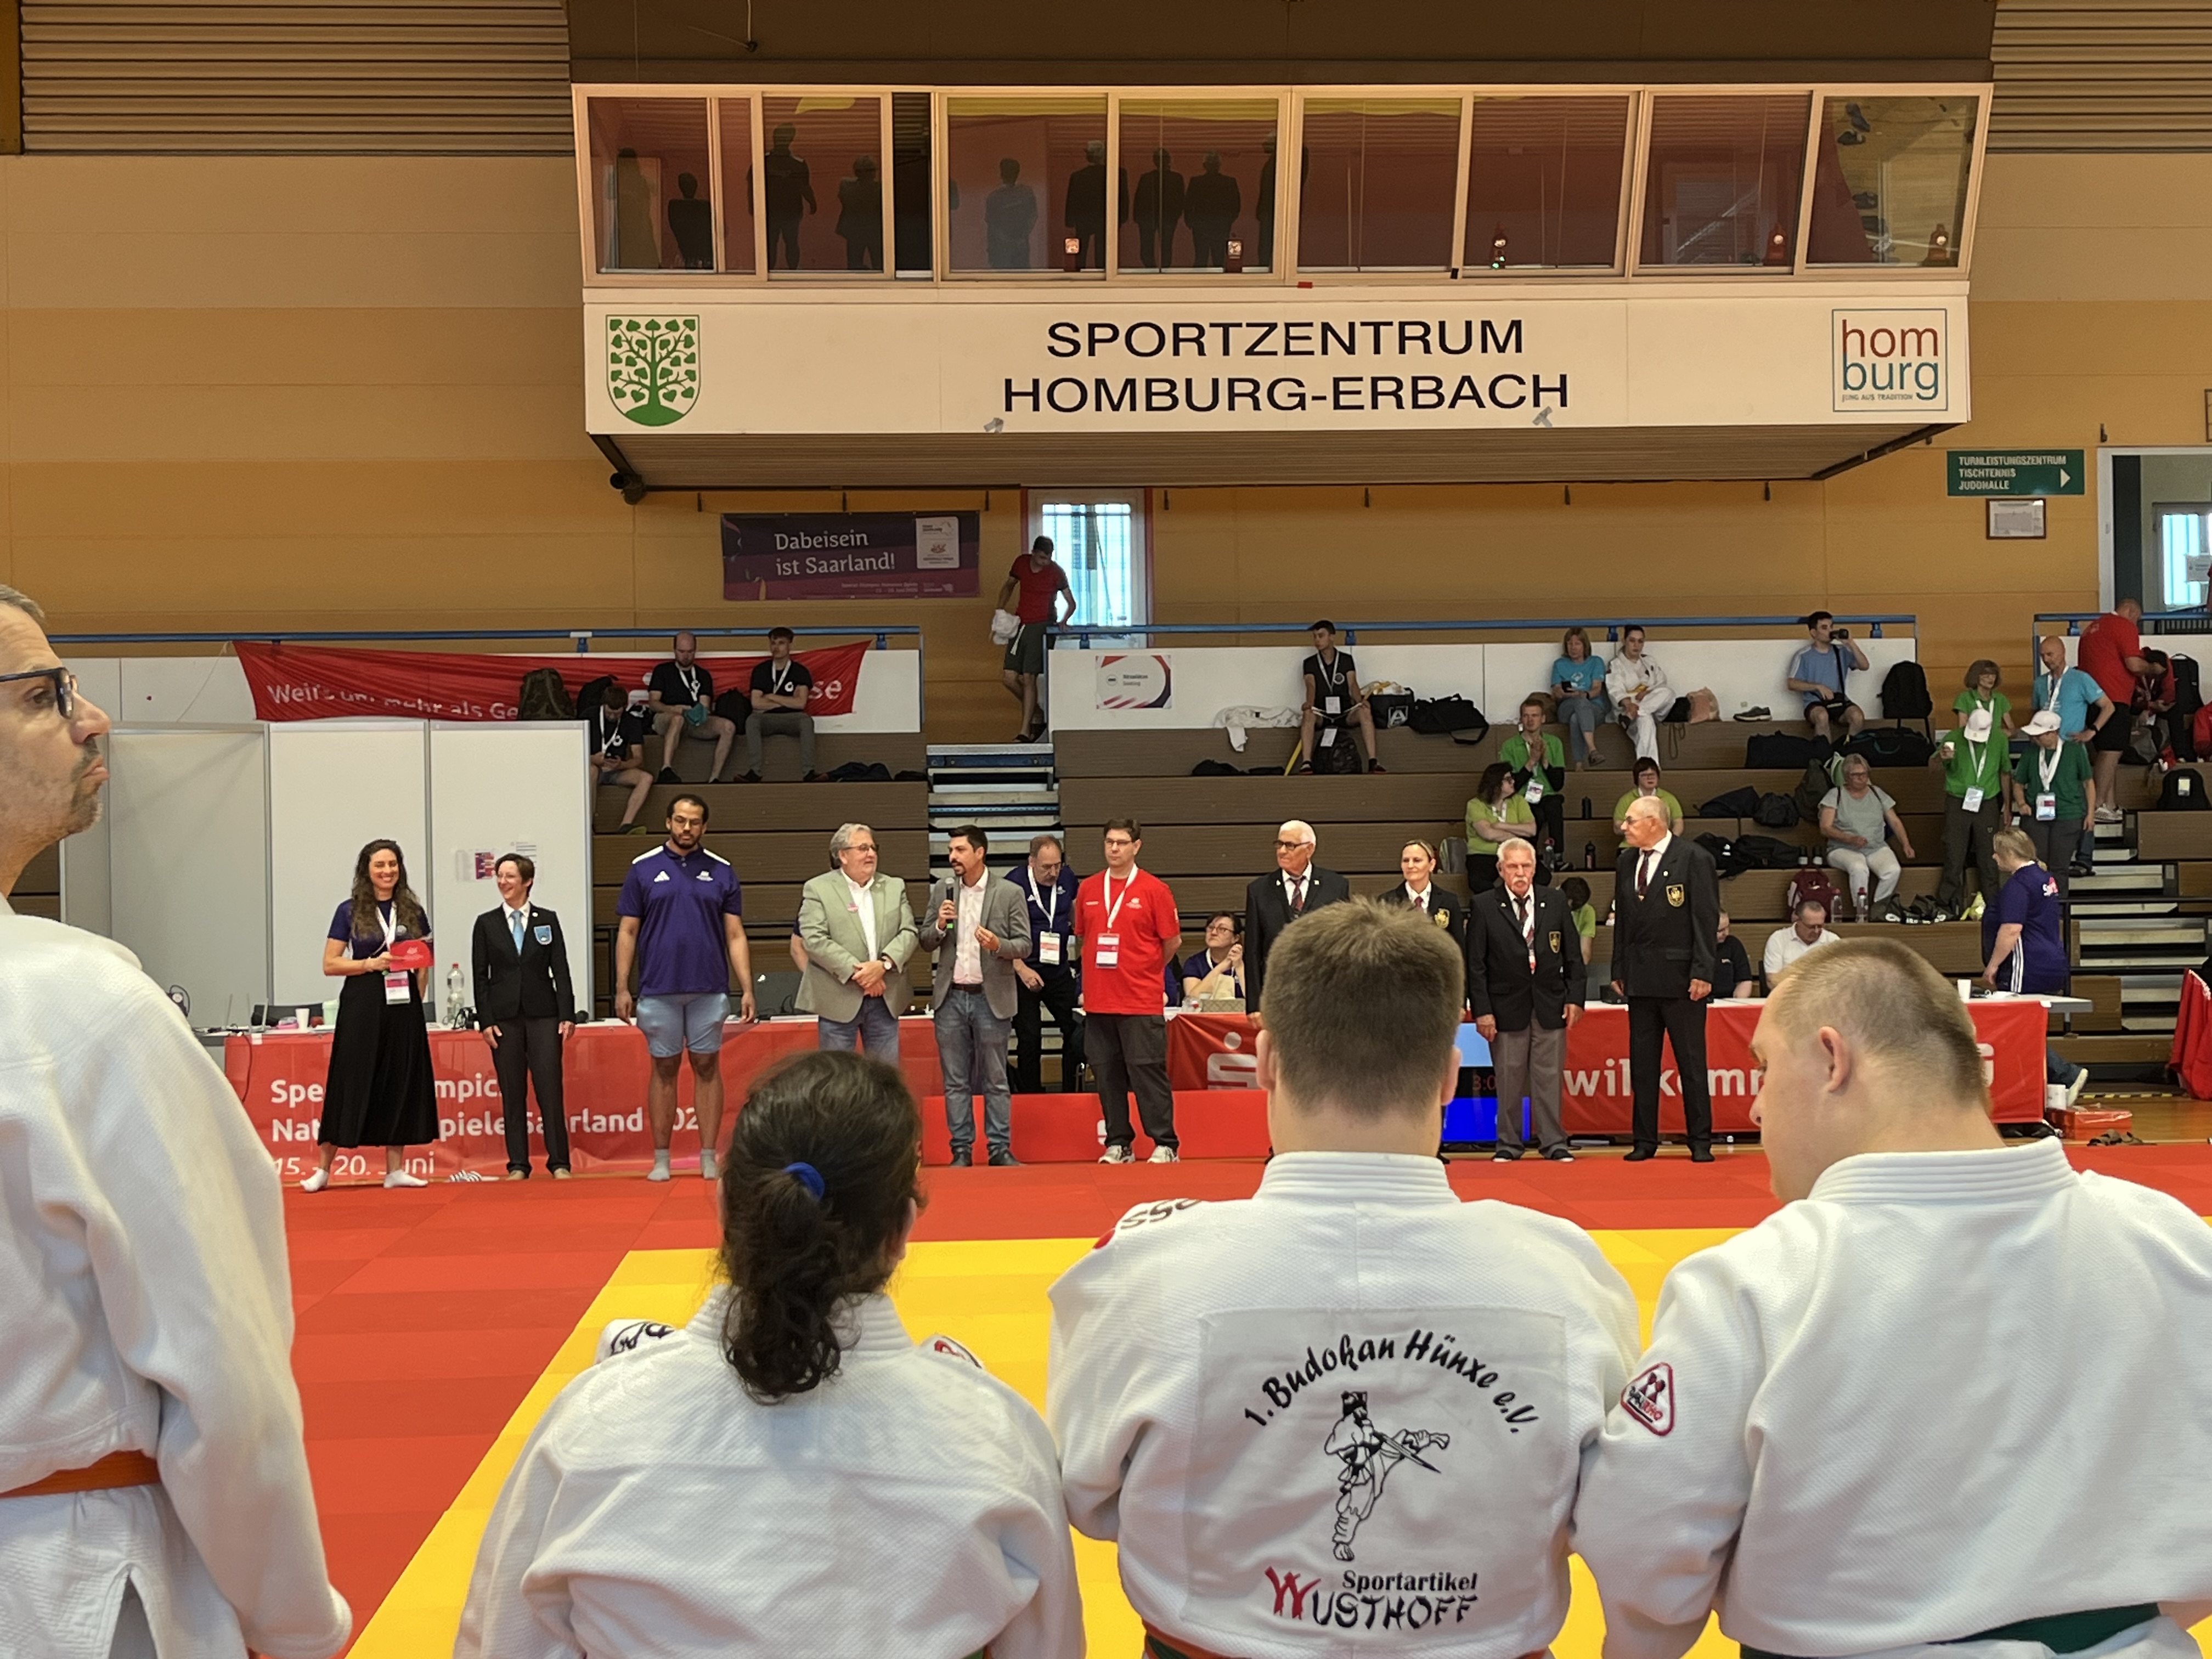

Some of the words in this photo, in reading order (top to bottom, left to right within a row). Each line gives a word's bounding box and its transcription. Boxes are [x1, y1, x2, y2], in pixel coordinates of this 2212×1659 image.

[1047, 319, 1523, 358] SPORTZENTRUM
[1842, 319, 1938, 358] hom
[1842, 358, 1938, 401] burg
[1005, 374, 1568, 414] HOMBURG-ERBACH
[1958, 467, 2016, 478] TISCHTENNIS
[774, 529, 869, 550] Dabeisein
[776, 558, 800, 575] ist
[805, 552, 895, 574] Saarland!
[489, 702, 518, 719] Ge
[334, 1155, 371, 1175] 20.
[1244, 1406, 1274, 1426] 1.
[1262, 1334, 1395, 1409] Budokan
[1403, 1329, 1499, 1388] Hünxe
[1492, 1391, 1539, 1434] e.V.
[1342, 1570, 1478, 1594] Sportartikel
